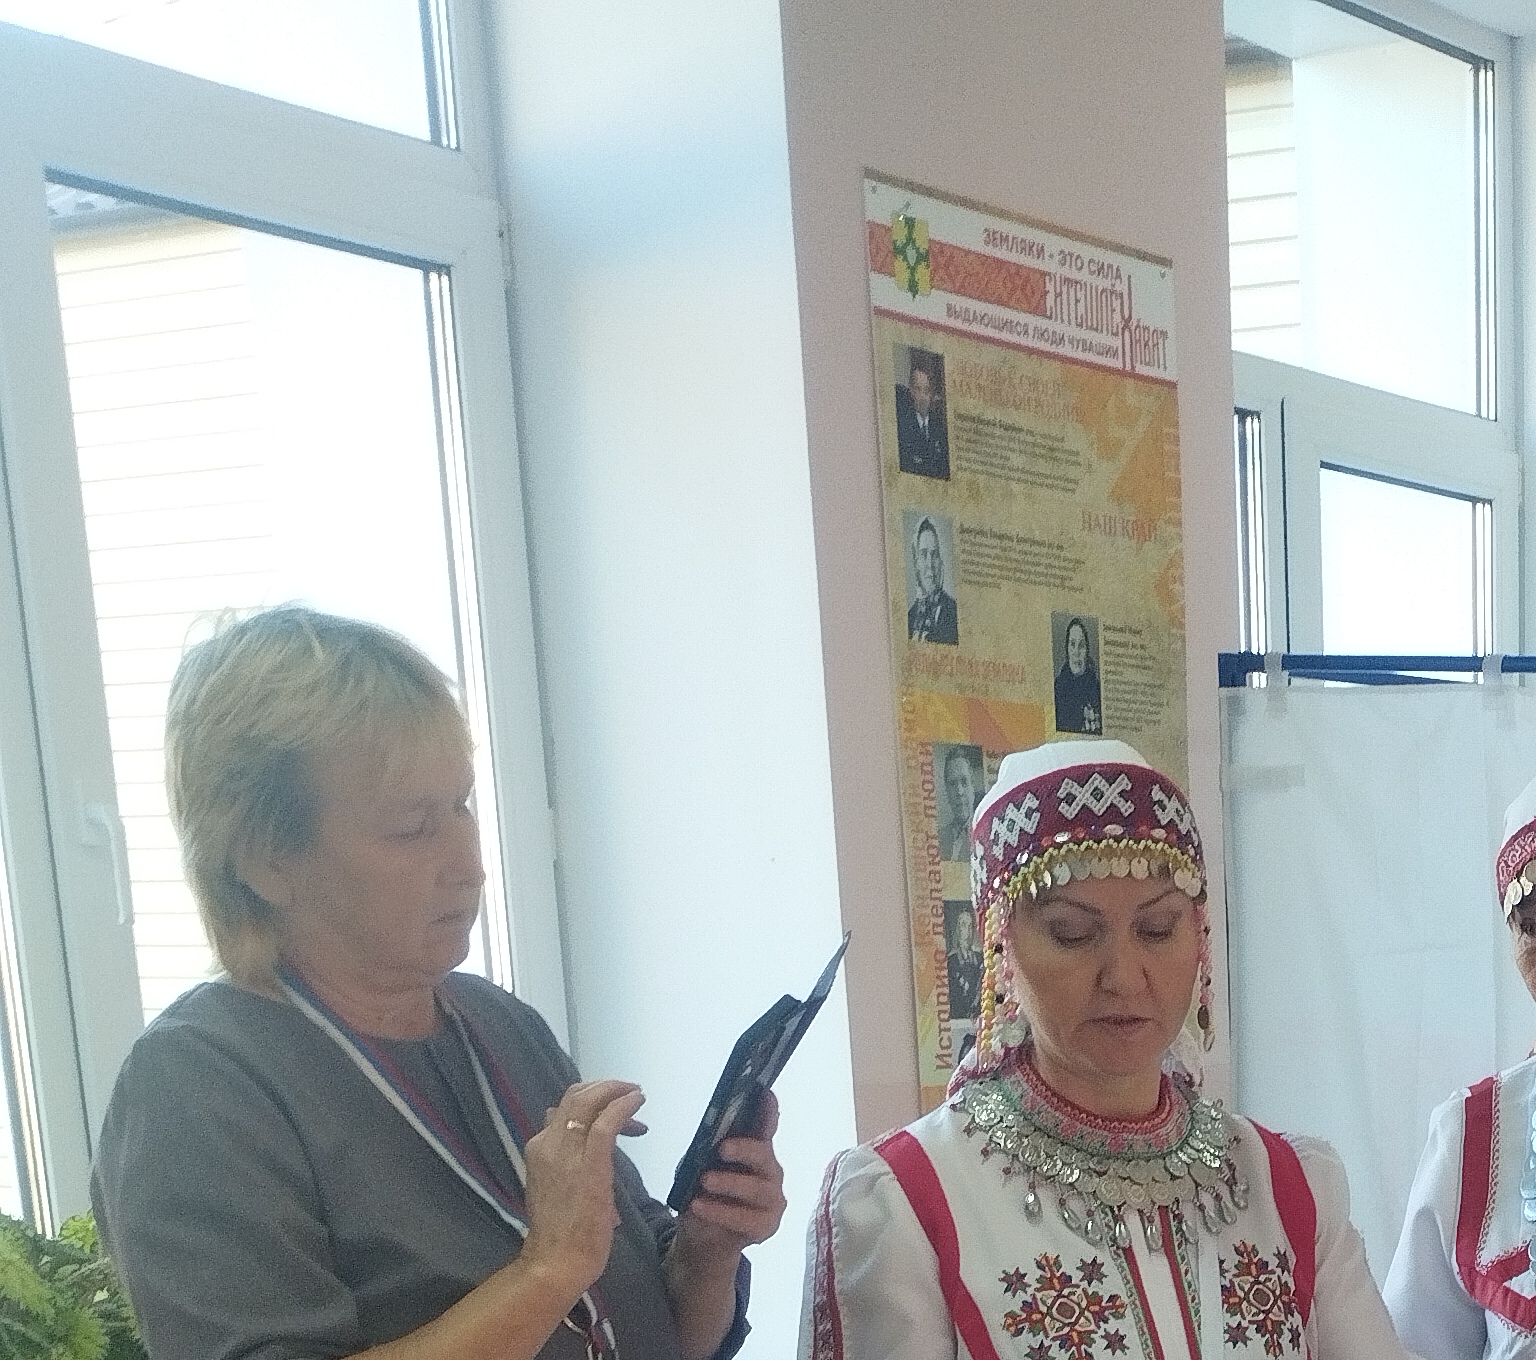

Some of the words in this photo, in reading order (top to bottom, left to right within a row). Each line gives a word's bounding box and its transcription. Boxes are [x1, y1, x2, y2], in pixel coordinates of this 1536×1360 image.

[982, 227, 1046, 261] ЗЕМЛЯКИ
[1058, 250, 1085, 271] ЭТО
[1088, 257, 1123, 284] СИЛА
[935, 950, 953, 1071] Историю
